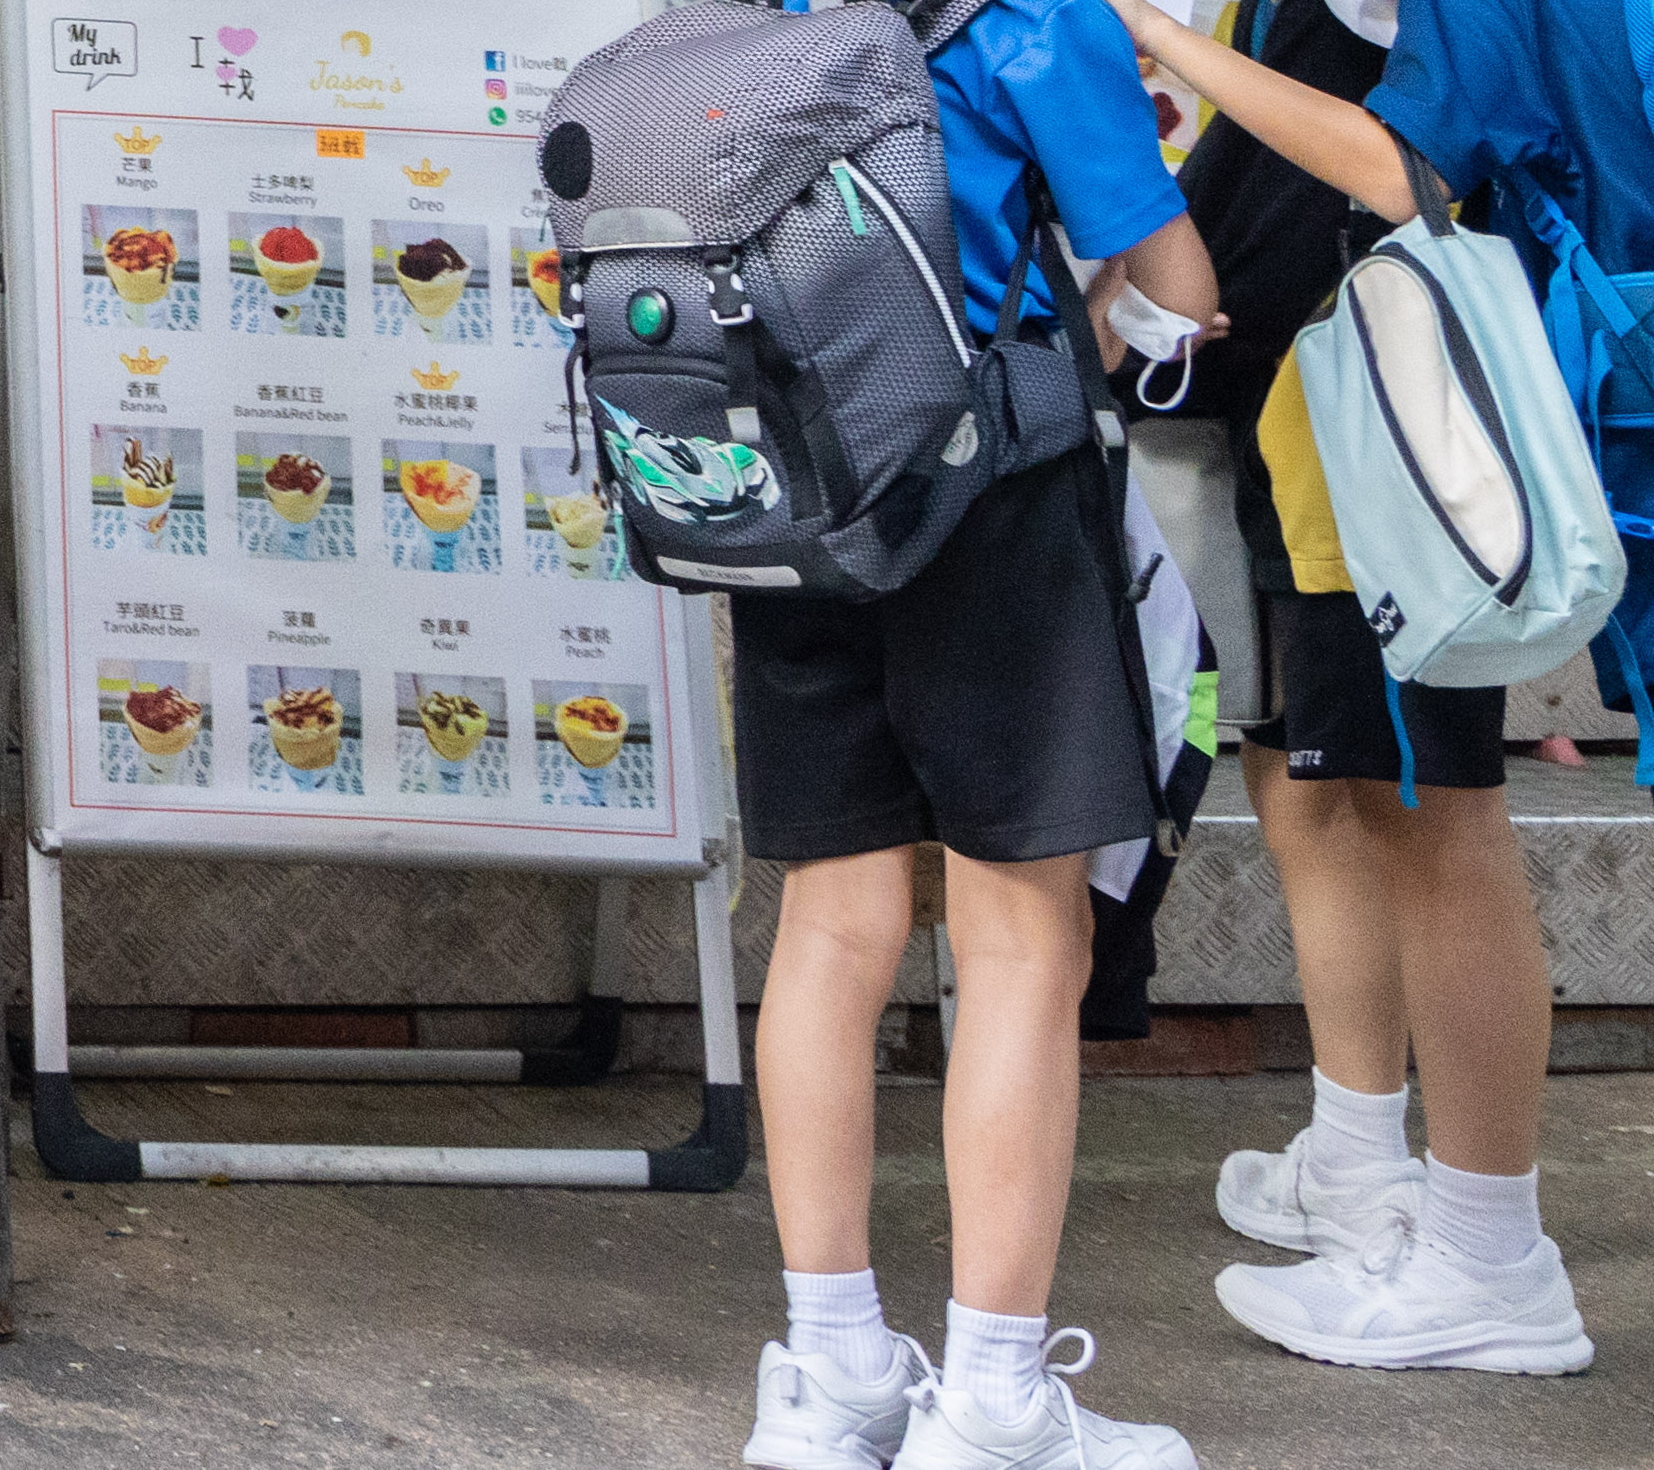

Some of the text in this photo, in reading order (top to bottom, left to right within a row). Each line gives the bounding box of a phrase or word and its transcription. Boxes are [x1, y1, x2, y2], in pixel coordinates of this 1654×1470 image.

[67, 24, 98, 47] My
[70, 48, 121, 67] drink
[116, 175, 158, 191] Mango
[249, 191, 317, 209] Strawberry
[408, 196, 445, 213] Oreo
[127, 382, 160, 399] 香蕉
[120, 400, 167, 414] Banana
[267, 629, 331, 647] Pineapple
